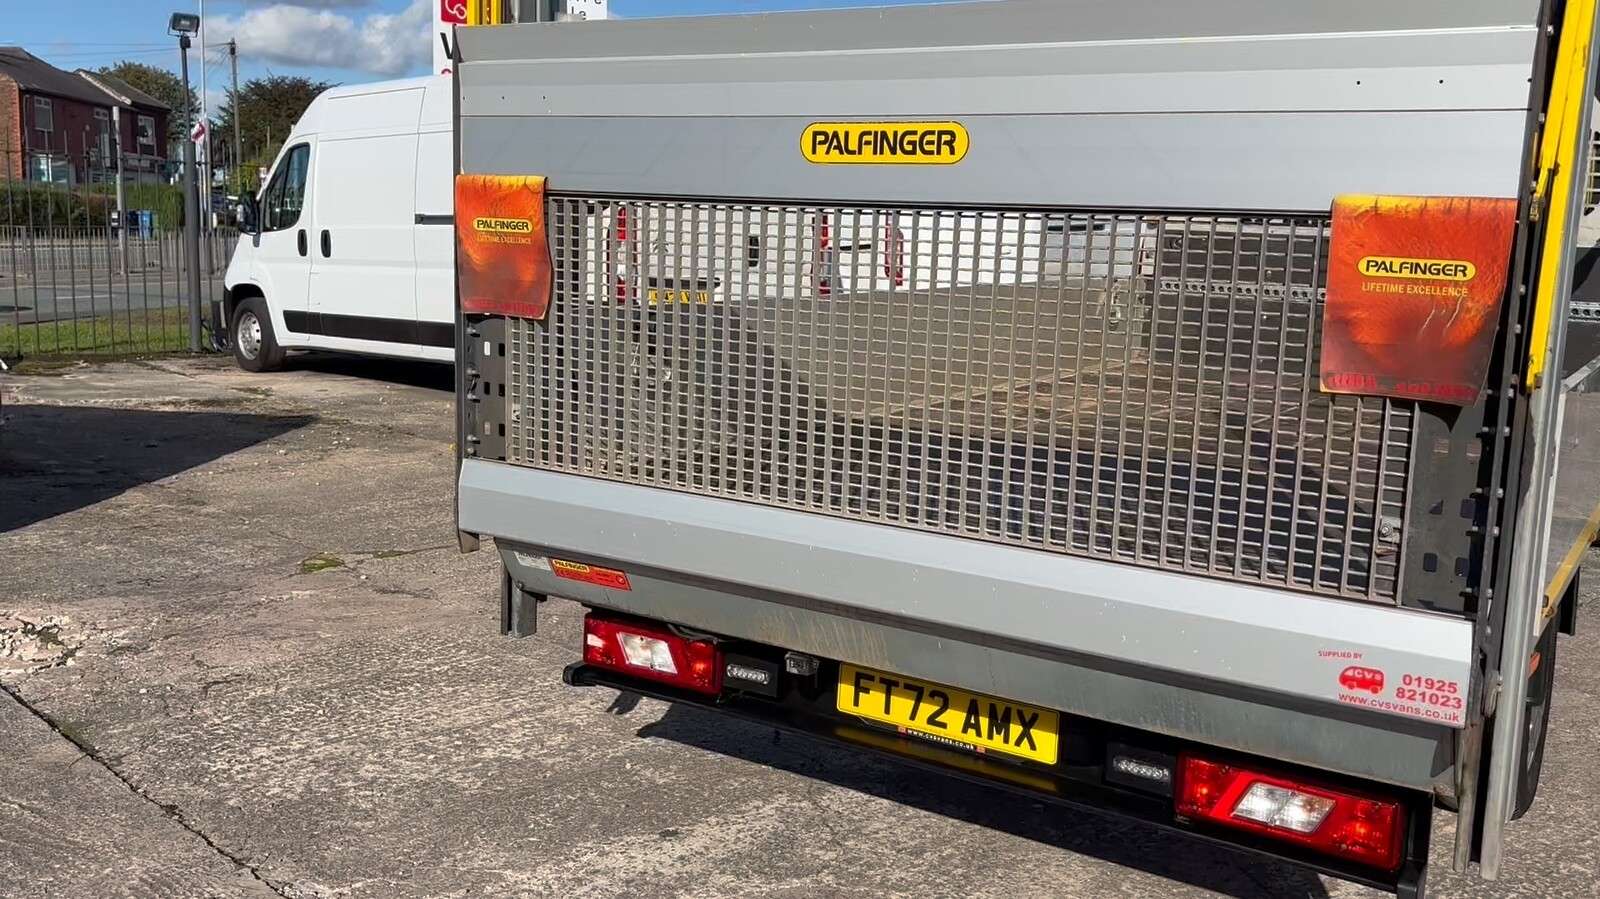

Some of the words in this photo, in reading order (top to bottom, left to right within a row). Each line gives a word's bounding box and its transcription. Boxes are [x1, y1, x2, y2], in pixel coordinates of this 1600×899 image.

[811, 130, 957, 155] PALFINGER
[477, 219, 529, 230] PALFINGER
[1365, 259, 1468, 278] PALFINGER
[1361, 281, 1405, 294] LIFETIME
[1406, 284, 1468, 297] EXCELLENCE
[1318, 650, 1351, 659] SUPPLIED
[1353, 652, 1363, 660] BY
[1354, 668, 1382, 681] CVS
[1402, 674, 1459, 695] 01925
[1338, 693, 1460, 722] www.cvsvans.co.uk
[1395, 686, 1463, 710] 821023
[852, 671, 950, 730] FT72
[961, 696, 1040, 752] AMX
